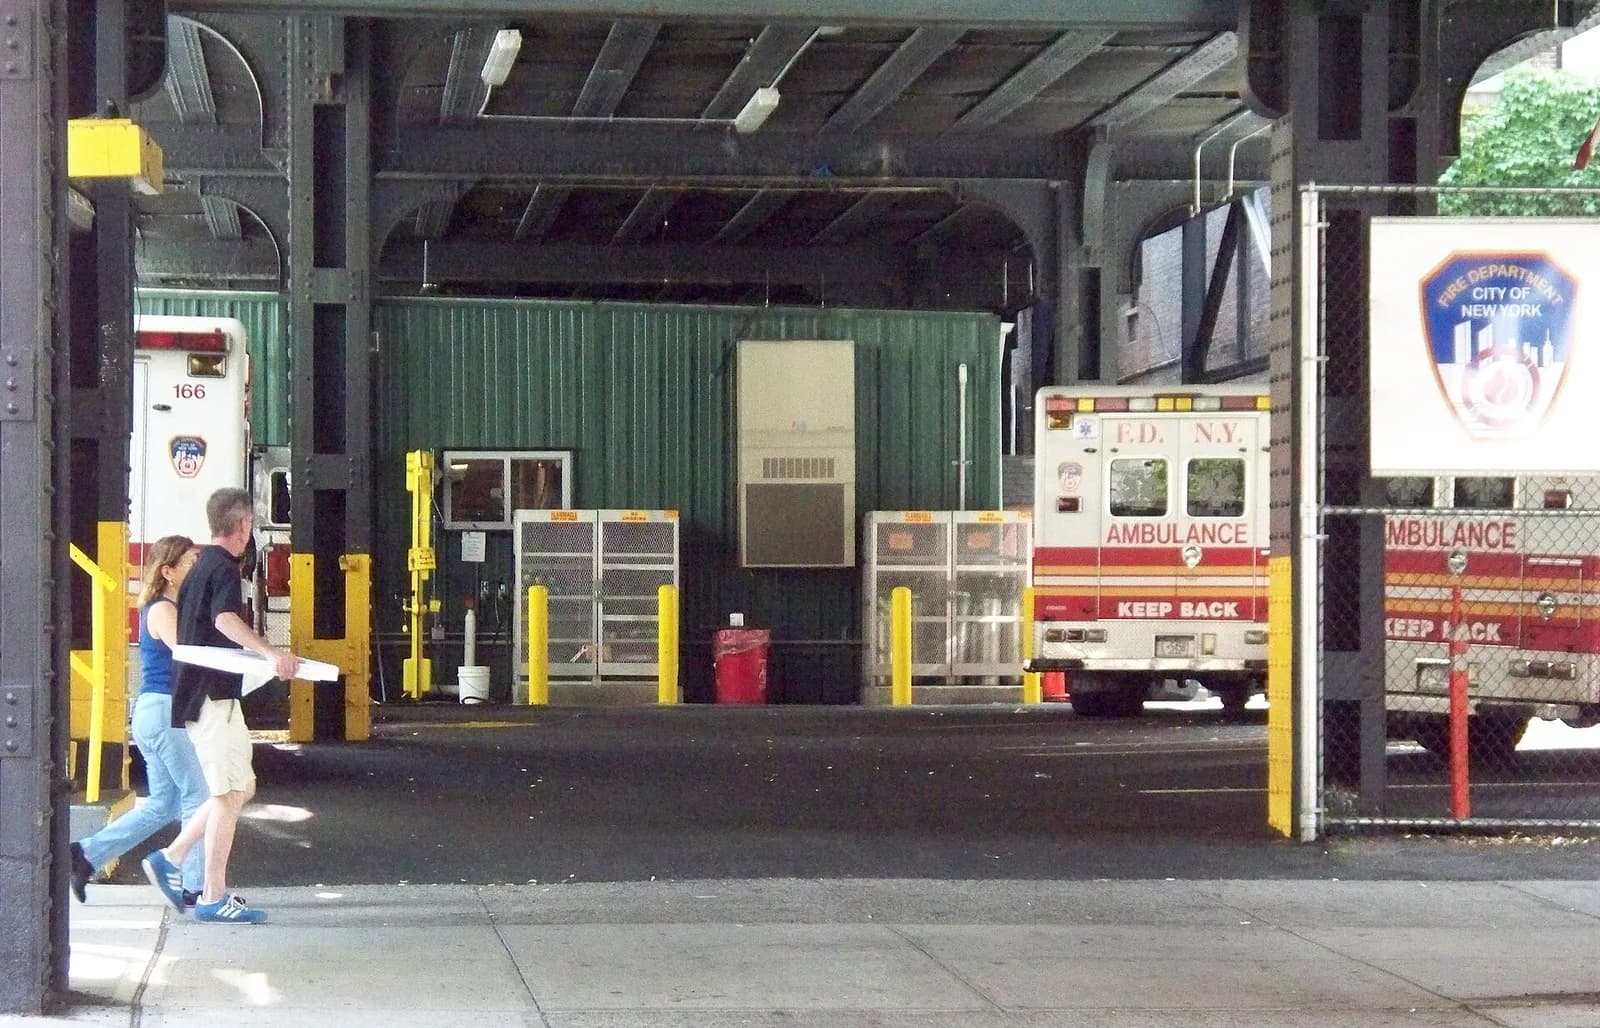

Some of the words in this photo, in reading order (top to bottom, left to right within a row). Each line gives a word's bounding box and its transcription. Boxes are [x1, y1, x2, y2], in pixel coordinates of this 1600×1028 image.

[1438, 276, 1469, 307] FIRE
[1467, 264, 1564, 305] DEPARTMENT
[1472, 286, 1507, 300] CITY
[1509, 286, 1531, 300] OF
[1461, 303, 1497, 317] NEW
[1499, 303, 1543, 317] YORK
[172, 383, 206, 399] 166
[1116, 422, 1165, 443] F.D.
[1194, 422, 1243, 443] N.Y.
[1106, 522, 1249, 544] AMBULANCE
[1386, 519, 1517, 548] MBULANCE
[1117, 601, 1173, 617] KEEP
[1179, 601, 1239, 617] BACK
